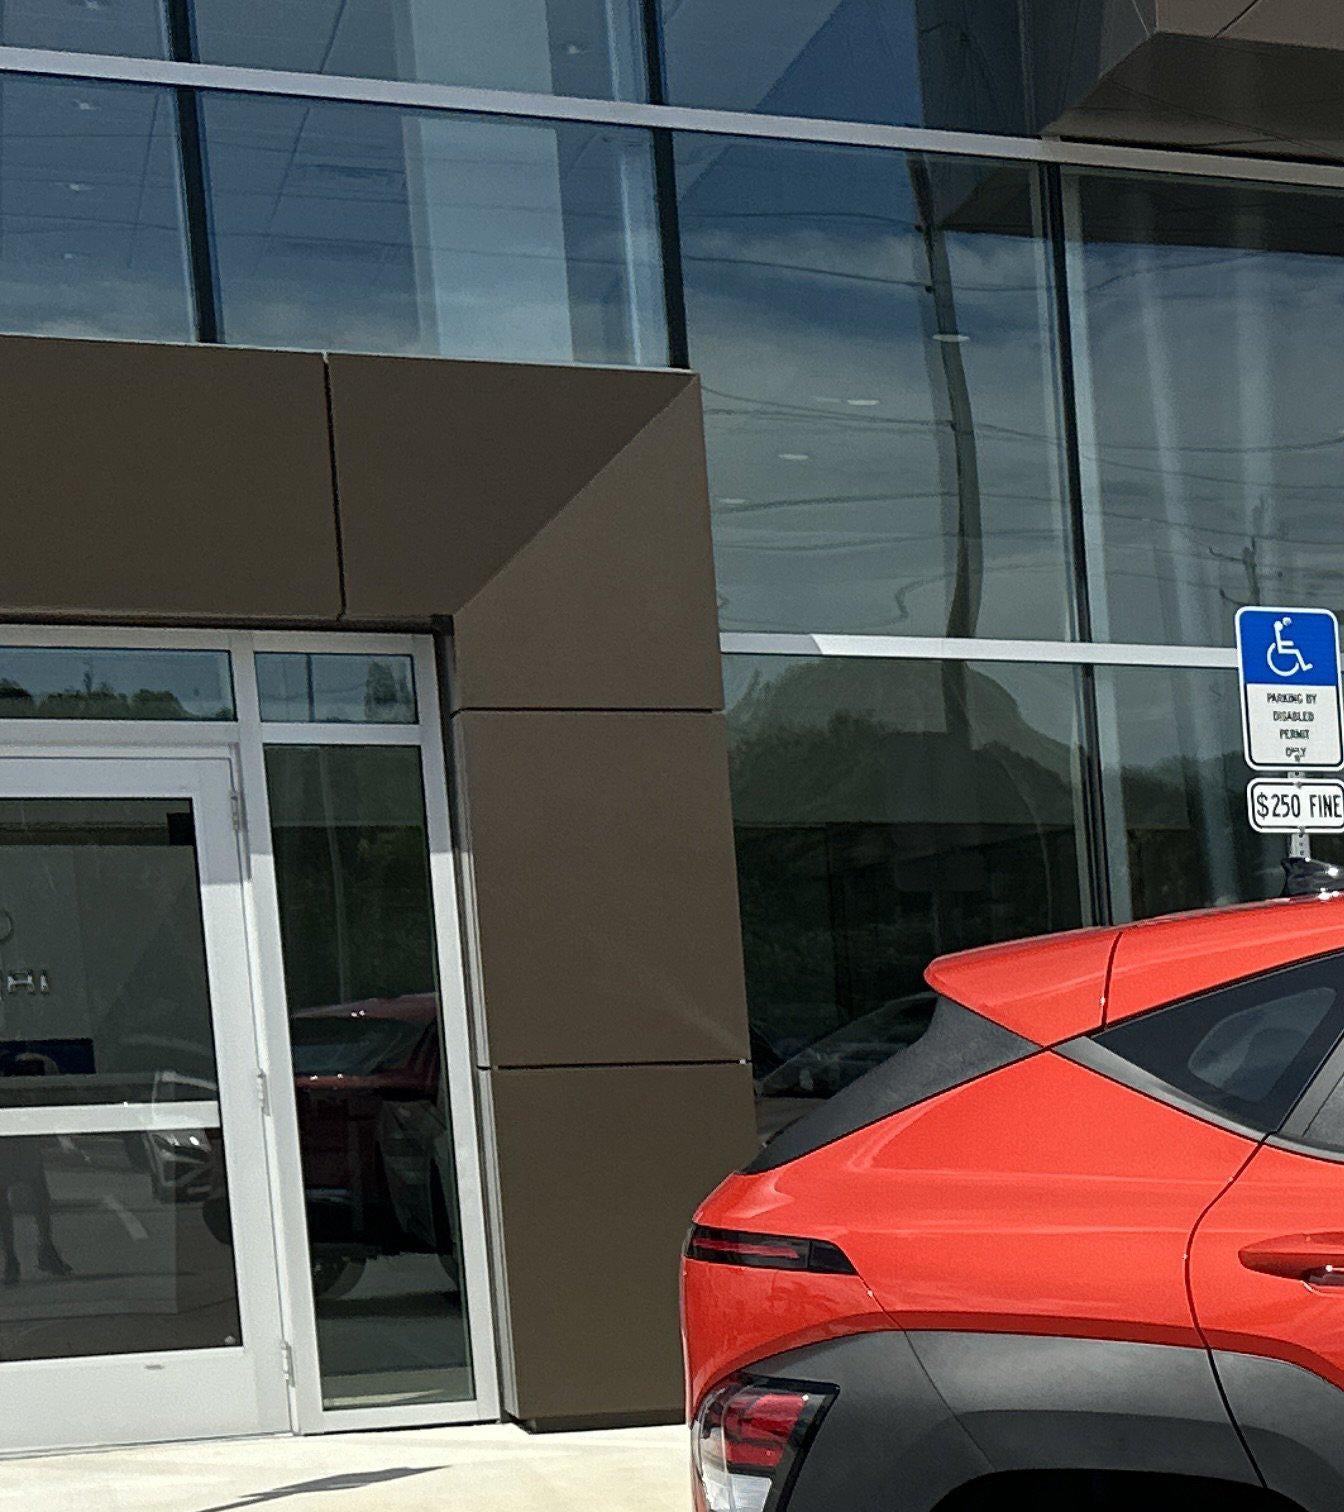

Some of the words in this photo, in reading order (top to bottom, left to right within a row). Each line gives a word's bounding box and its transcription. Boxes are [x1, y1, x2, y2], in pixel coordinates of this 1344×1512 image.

[1266, 693, 1303, 704] PARKING
[1306, 693, 1317, 704] BY
[1273, 711, 1315, 722] DISABLED
[1279, 729, 1310, 740] PERMIT
[1256, 792, 1301, 820] $250
[1309, 794, 1342, 818] FINE
